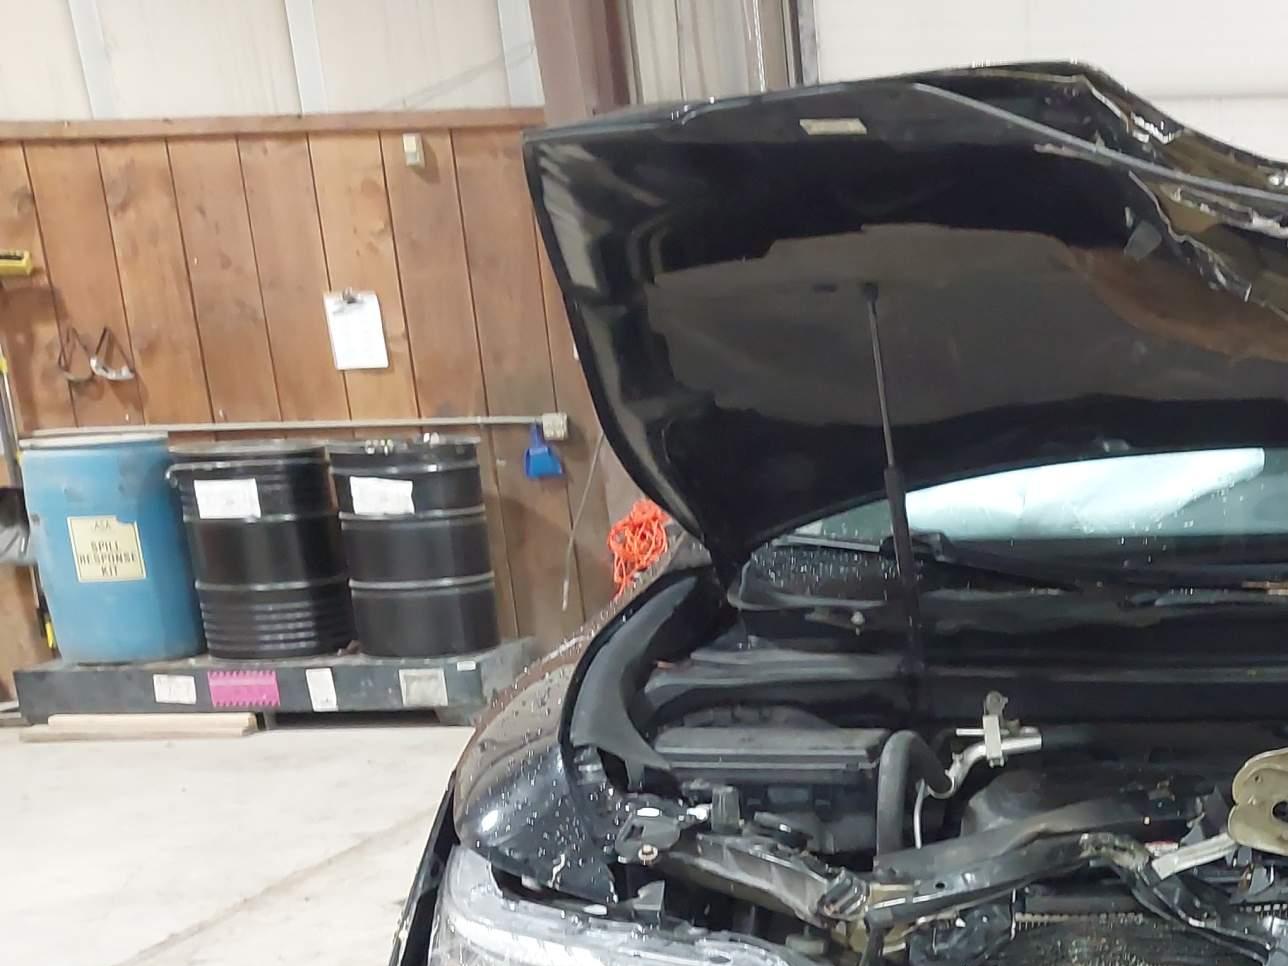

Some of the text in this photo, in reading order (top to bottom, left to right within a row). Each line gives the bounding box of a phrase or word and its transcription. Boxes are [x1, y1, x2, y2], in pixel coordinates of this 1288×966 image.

[90, 541, 120, 553] SPILL
[79, 552, 136, 565] RESPONSE
[101, 565, 119, 577] KIT
